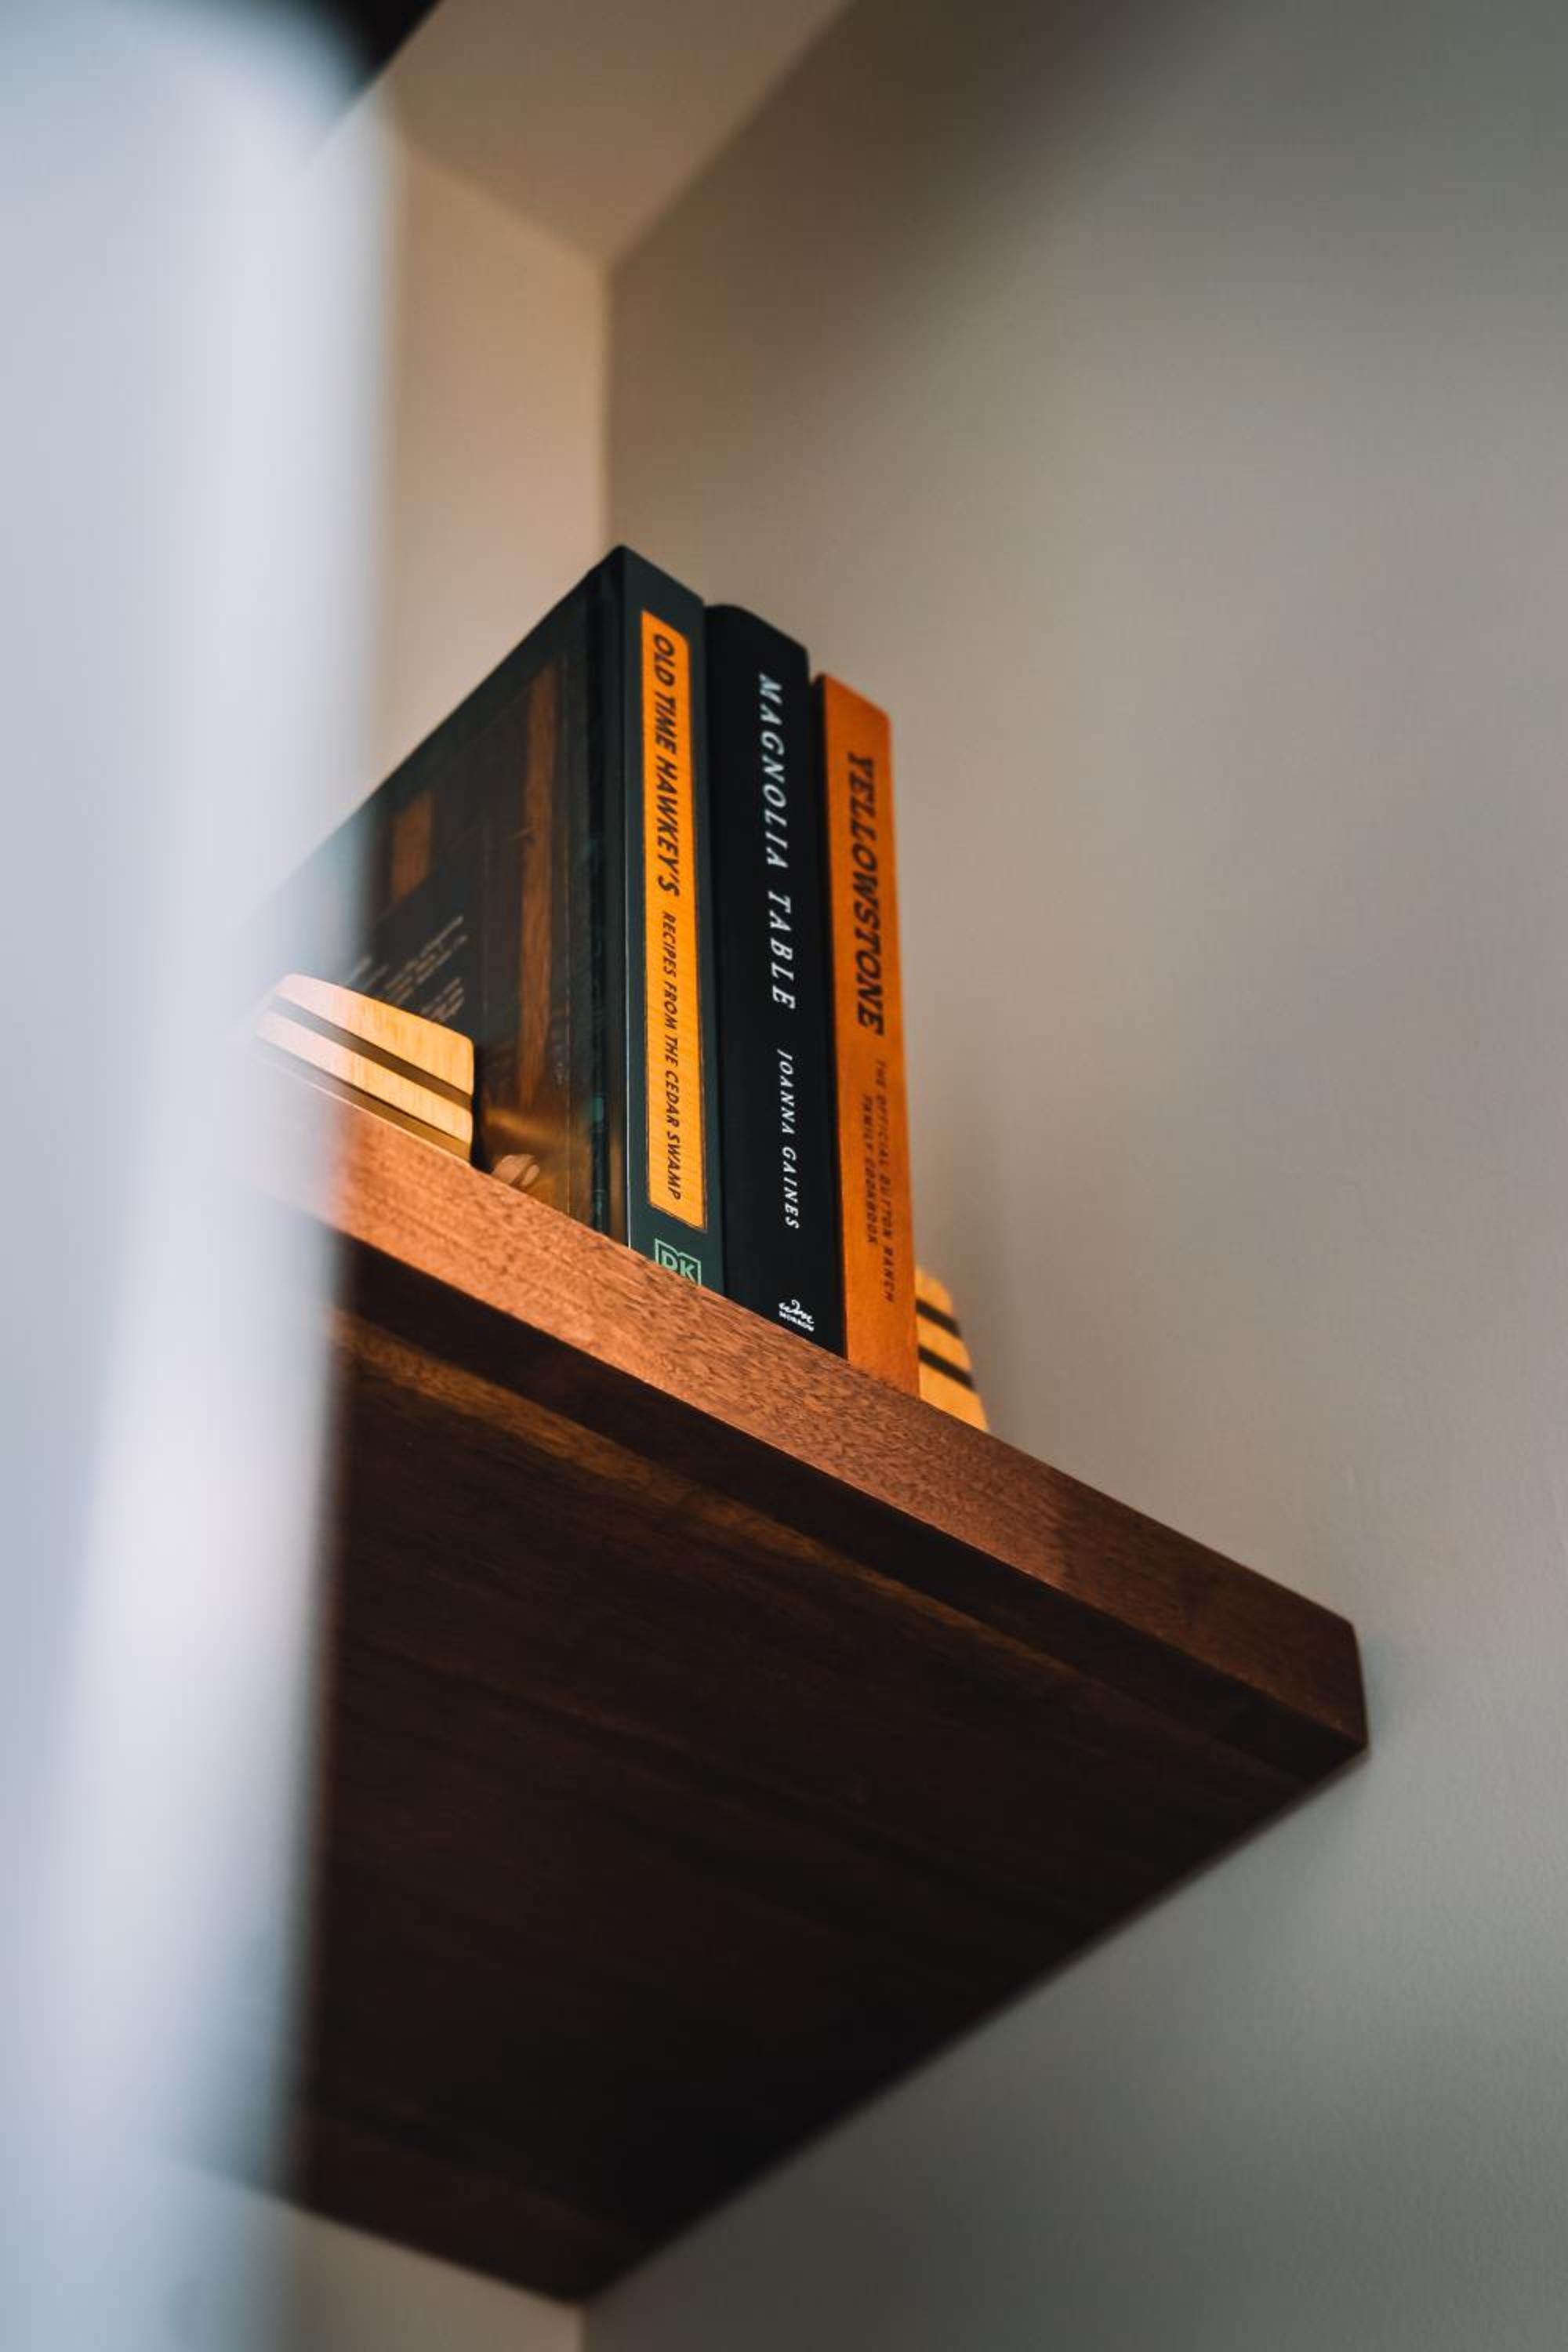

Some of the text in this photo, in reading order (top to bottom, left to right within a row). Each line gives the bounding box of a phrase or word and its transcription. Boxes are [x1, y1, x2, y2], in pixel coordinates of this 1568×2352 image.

[652, 633, 680, 897] OLD TIME HAWKEY'S
[758, 672, 797, 1010] MAGNOLIA TABLE
[848, 752, 884, 1037] YELLOWSTONE
[662, 909, 682, 1201] RECIPES FROM THE CEDAR SWAMP
[777, 1048, 800, 1230] JOANNA GAINES
[875, 1058, 887, 1088] THE
[883, 1246, 895, 1305] RANCH
[660, 1249, 699, 1284] DK
